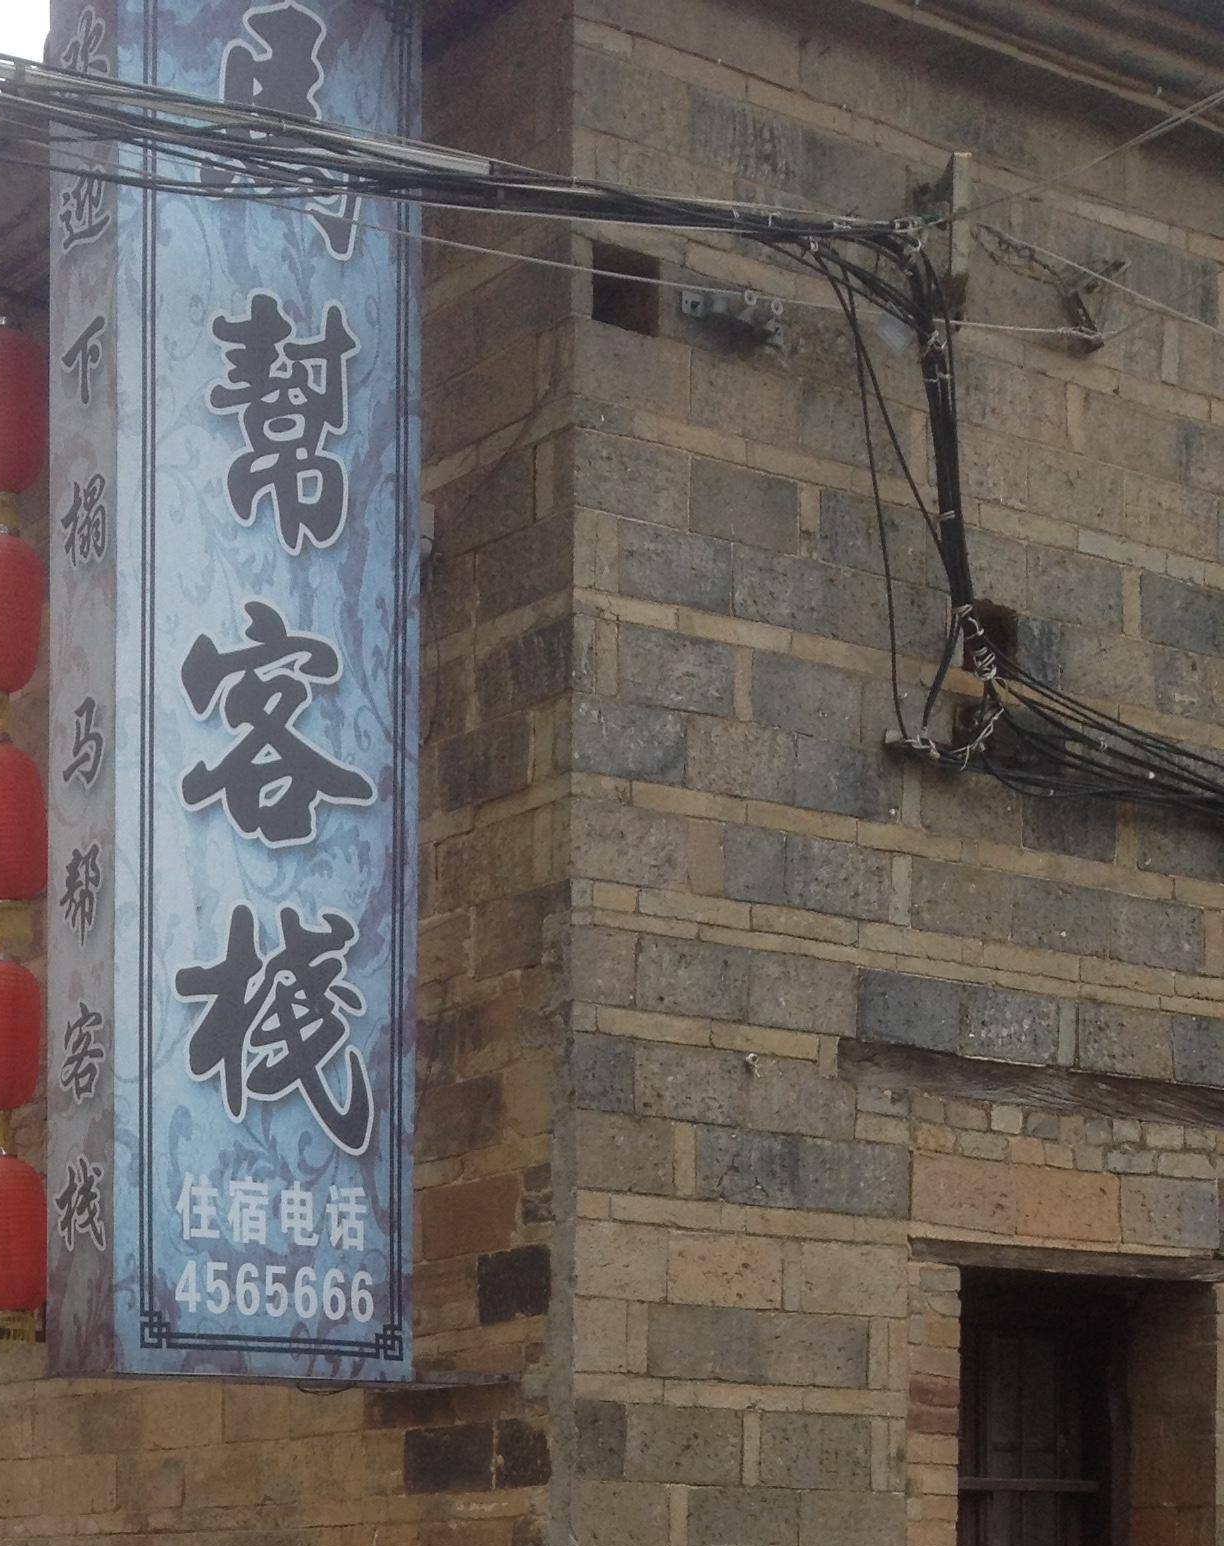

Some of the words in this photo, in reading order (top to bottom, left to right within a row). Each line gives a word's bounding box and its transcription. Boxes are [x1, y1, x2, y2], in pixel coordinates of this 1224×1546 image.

[176, 1172, 367, 1251] 住宿电话
[175, 1260, 374, 1322] 4565666
